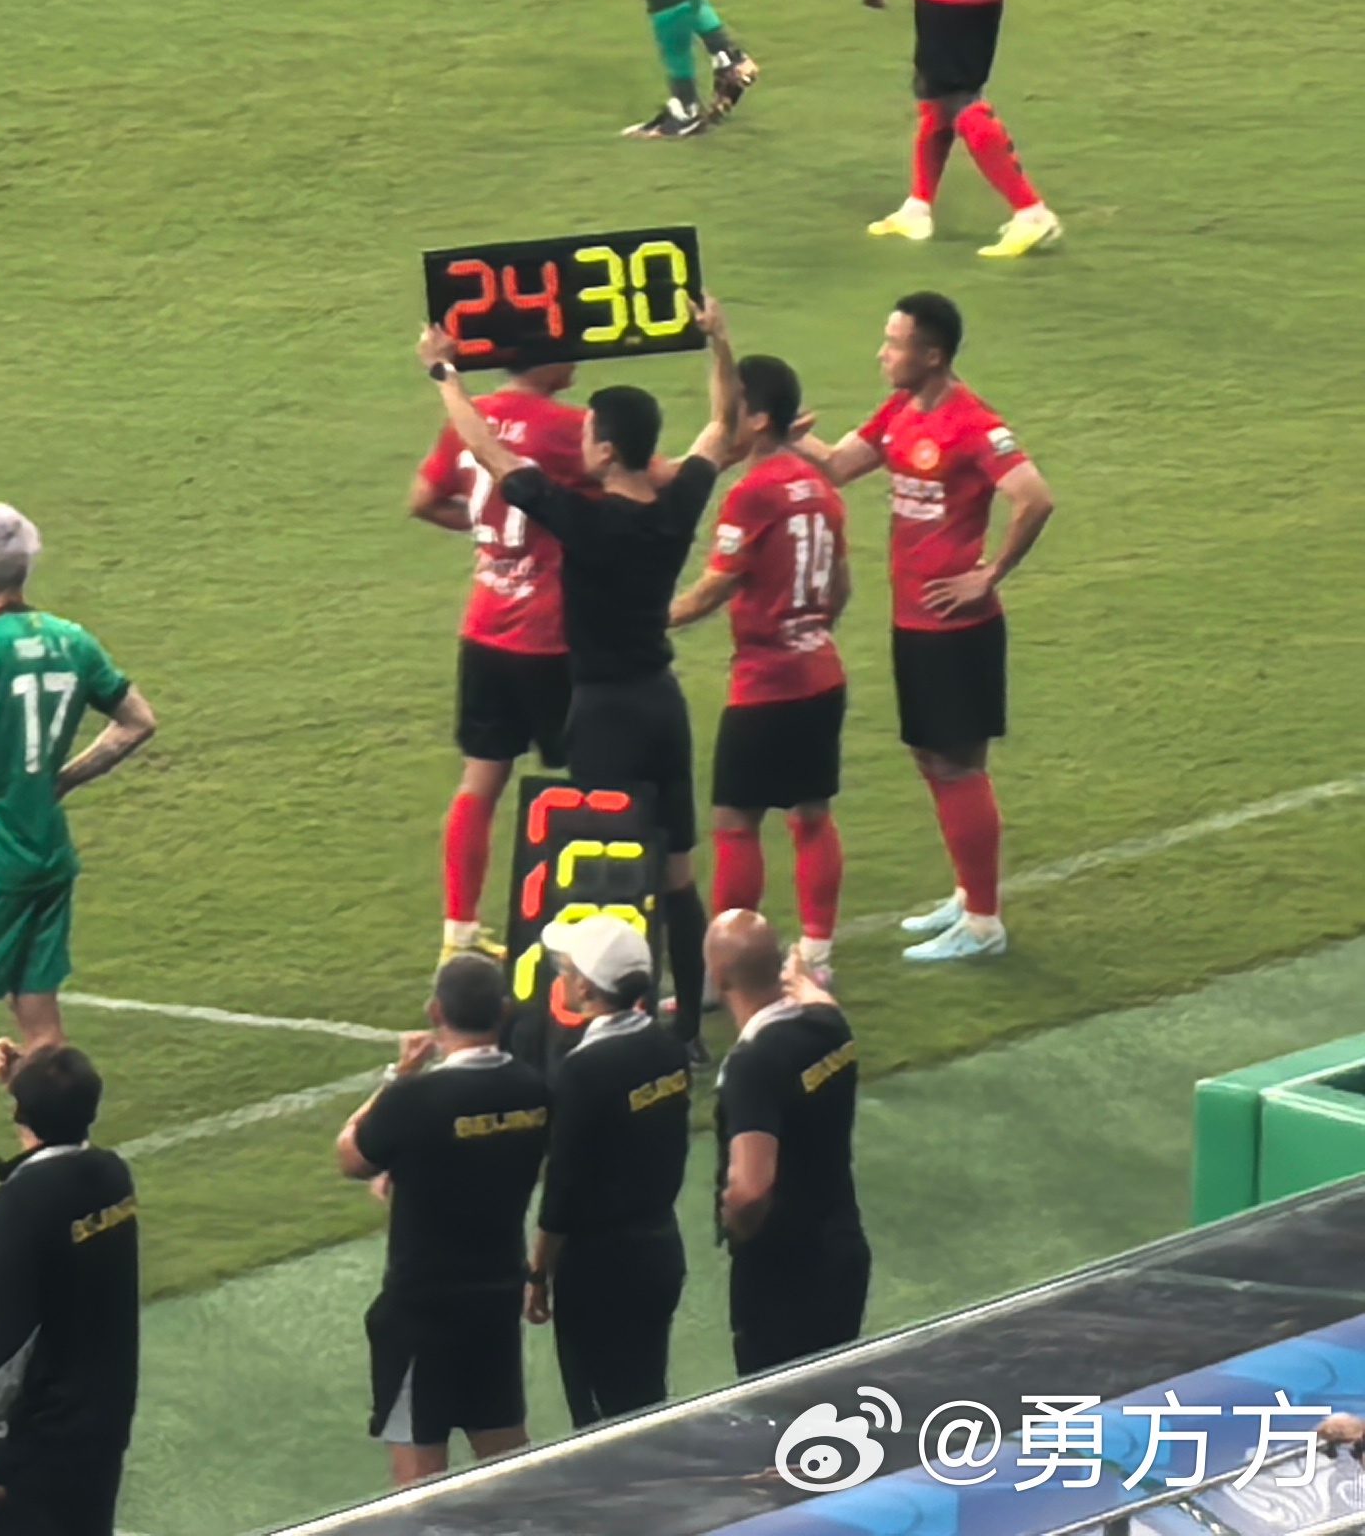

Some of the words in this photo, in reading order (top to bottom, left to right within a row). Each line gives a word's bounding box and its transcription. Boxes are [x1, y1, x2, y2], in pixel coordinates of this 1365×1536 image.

[444, 259, 564, 356] 24
[574, 240, 690, 343] 30
[12, 671, 78, 773] 17
